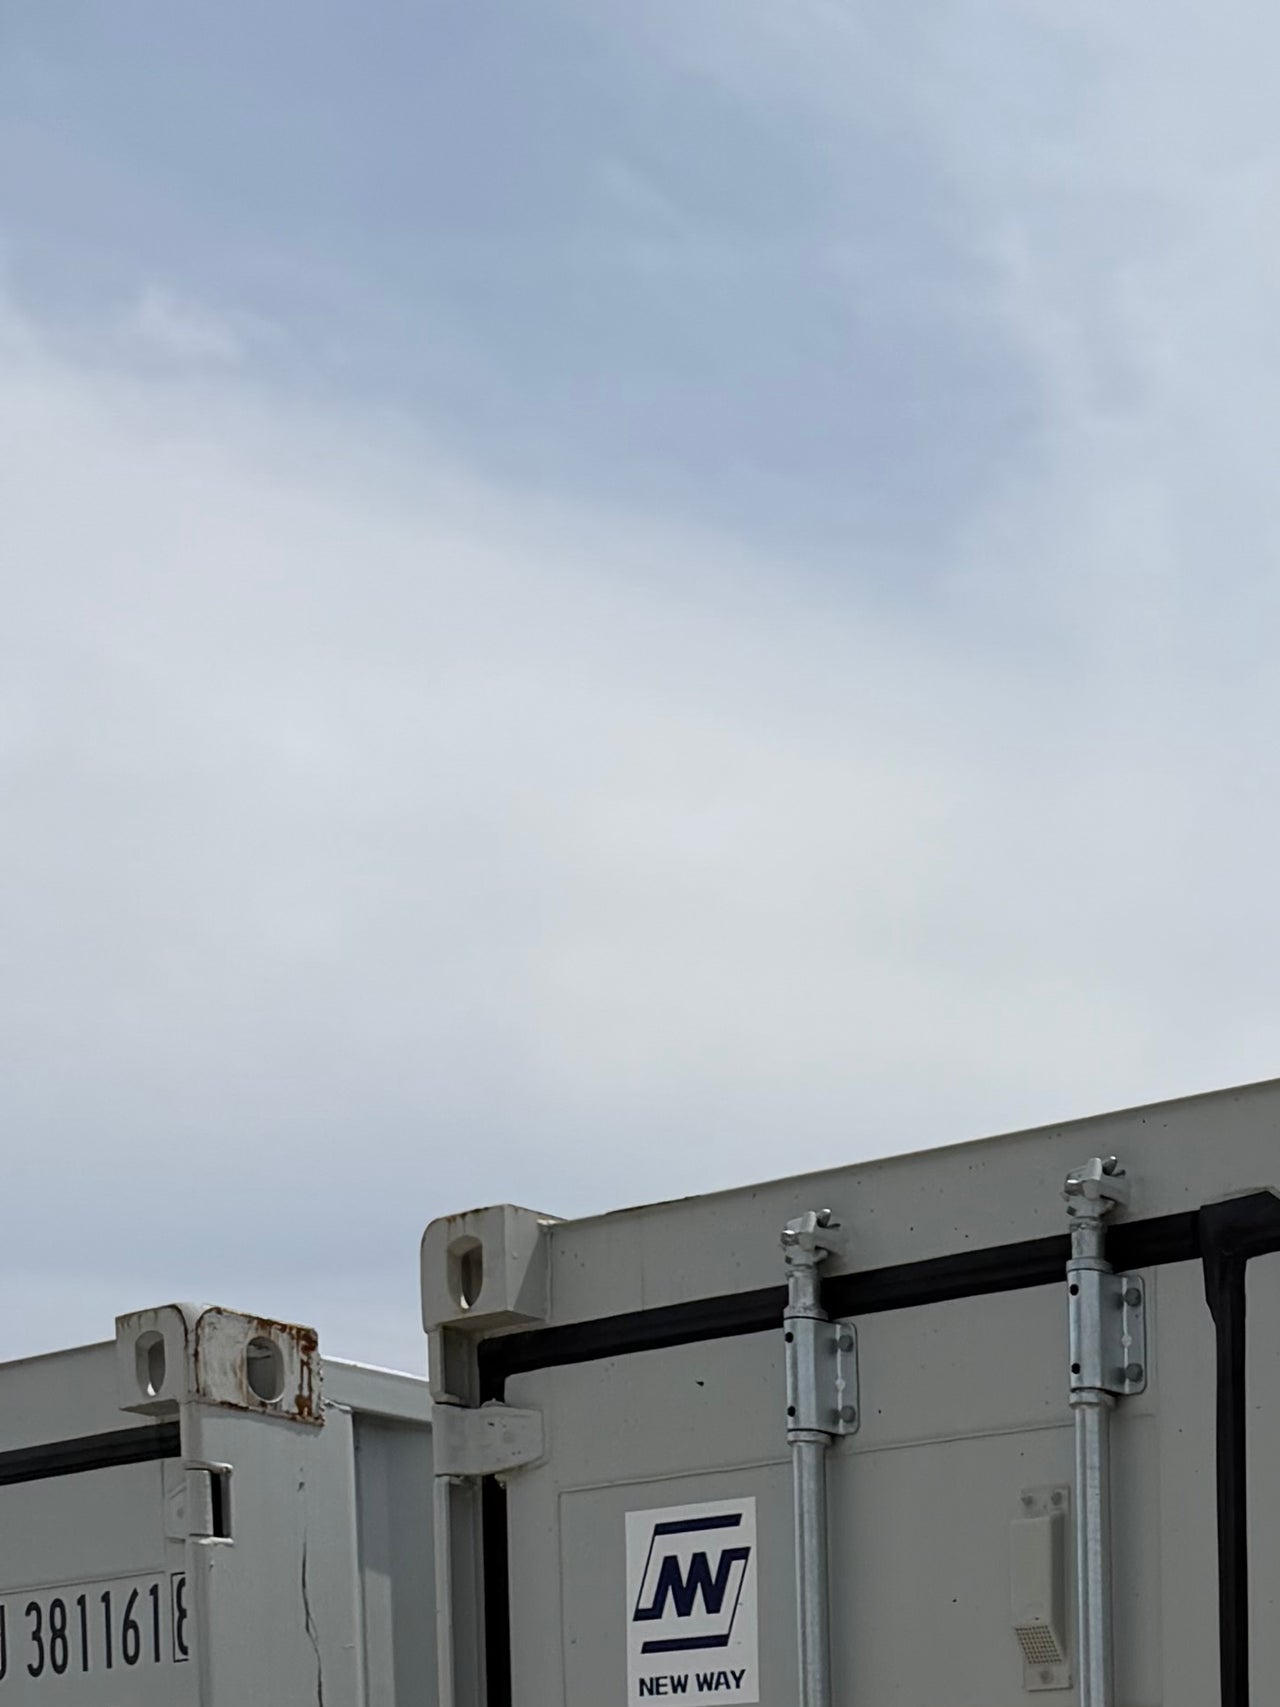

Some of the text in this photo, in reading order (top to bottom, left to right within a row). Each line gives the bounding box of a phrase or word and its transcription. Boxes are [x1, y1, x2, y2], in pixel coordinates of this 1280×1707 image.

[25, 1583, 161, 1678] 381161
[639, 1668, 746, 1697] NEW WAY
